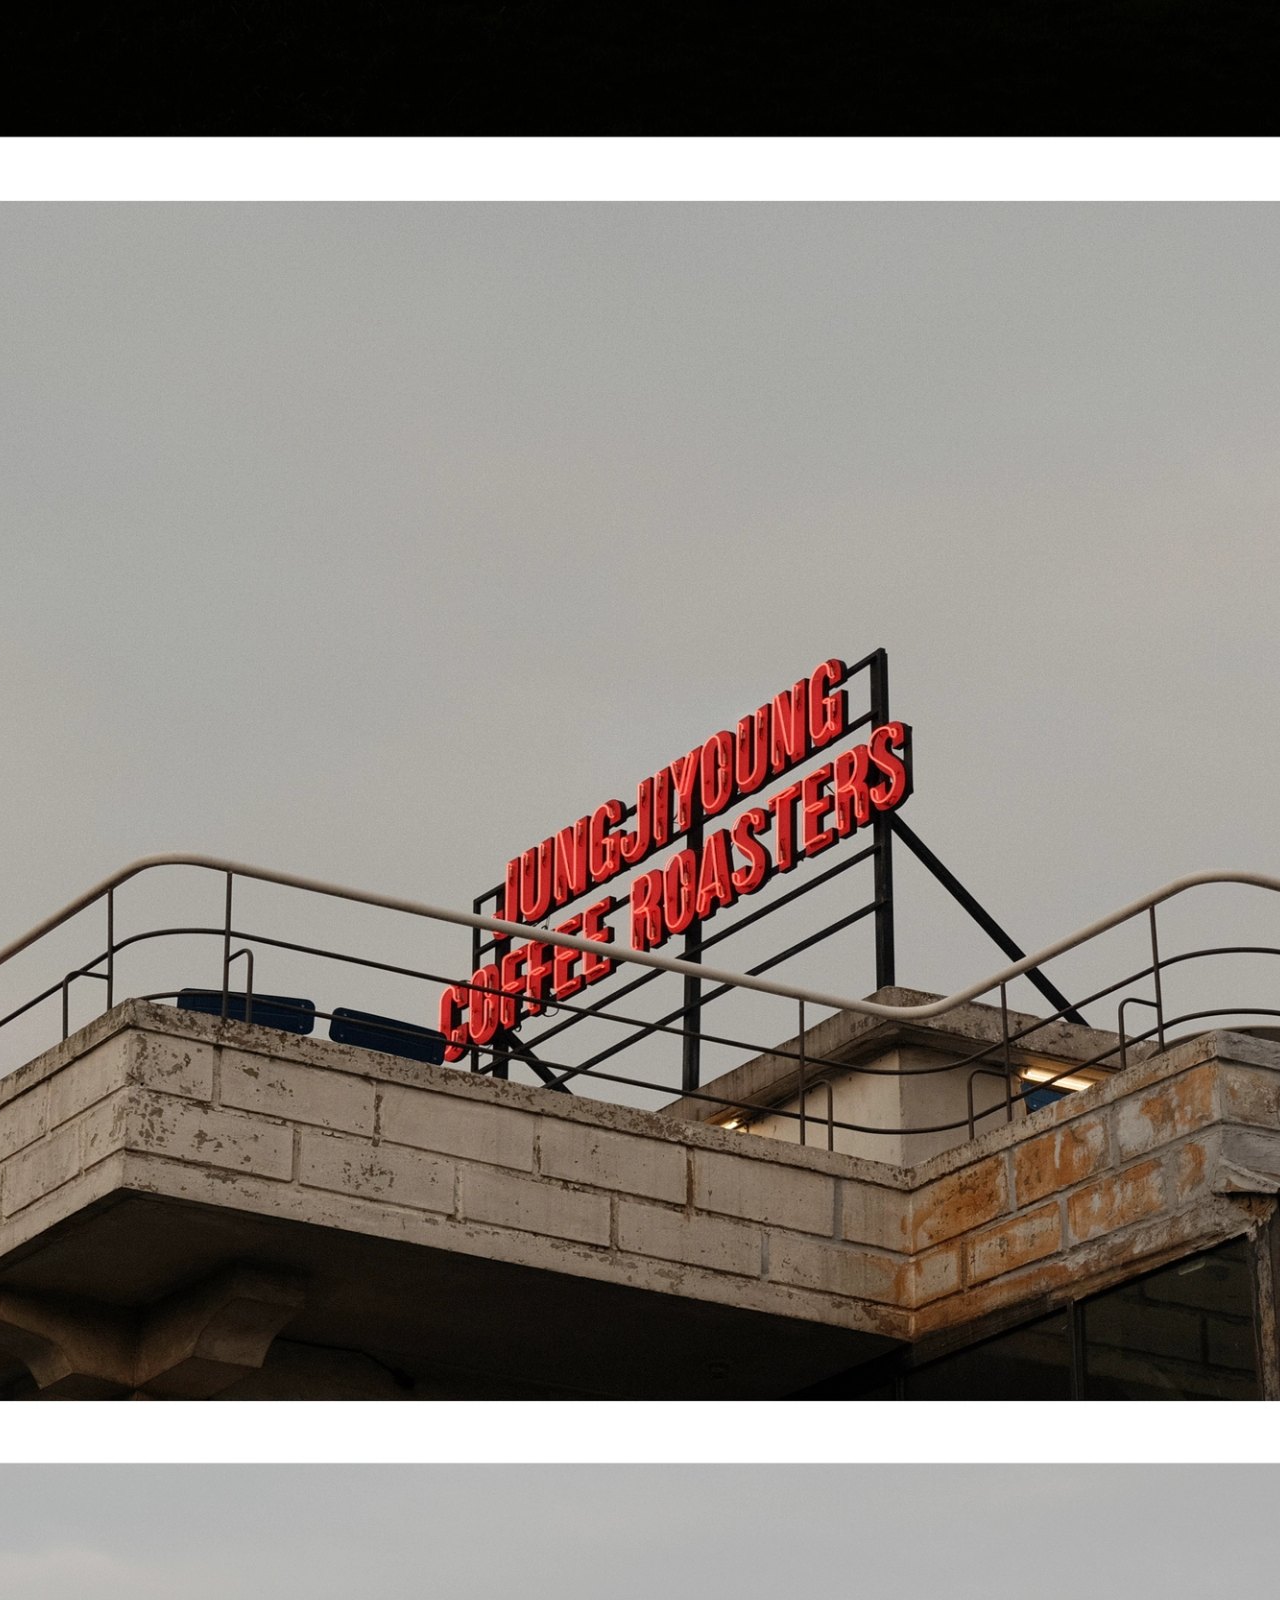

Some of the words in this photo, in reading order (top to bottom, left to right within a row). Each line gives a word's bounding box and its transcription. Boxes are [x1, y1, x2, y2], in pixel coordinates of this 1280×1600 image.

[439, 896, 616, 1063] COFFEE
[629, 721, 913, 952] ROASTERS
[492, 658, 847, 941] JUNGJIYOUNG
